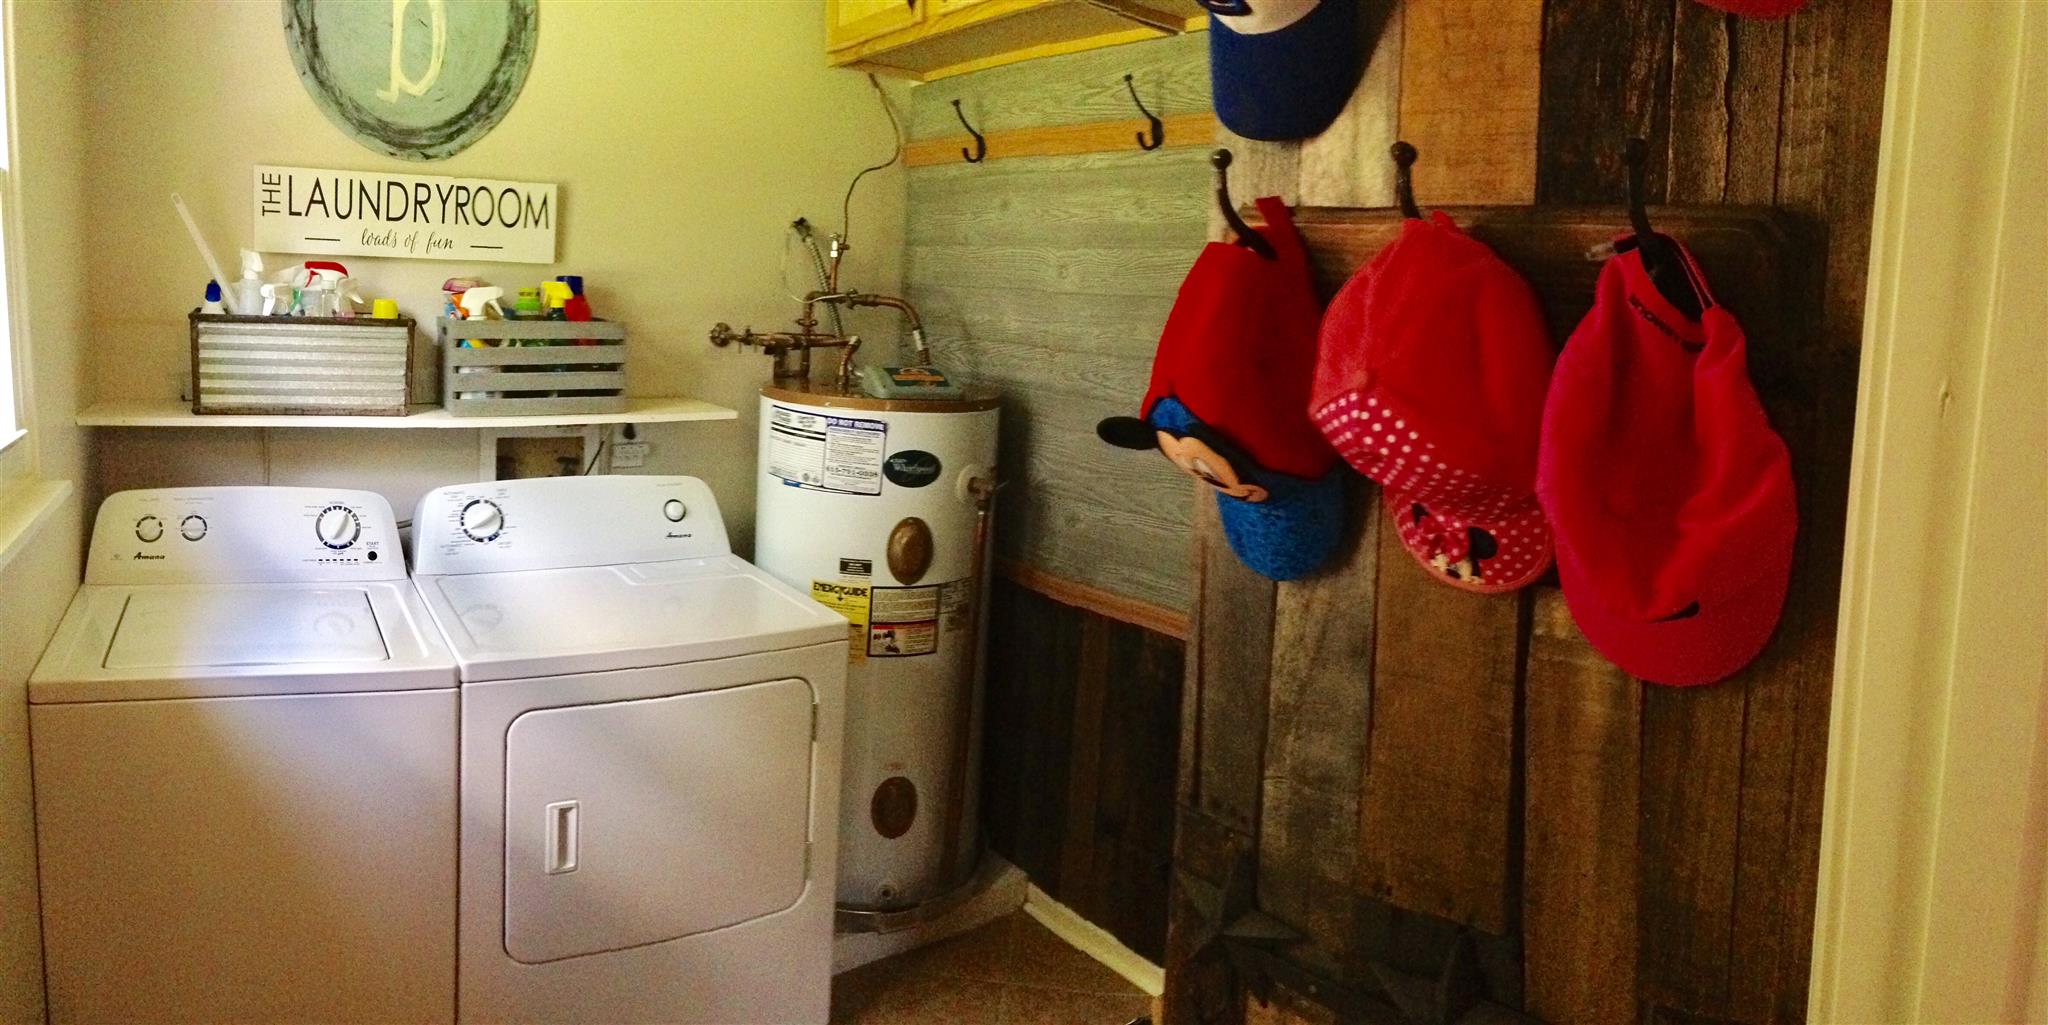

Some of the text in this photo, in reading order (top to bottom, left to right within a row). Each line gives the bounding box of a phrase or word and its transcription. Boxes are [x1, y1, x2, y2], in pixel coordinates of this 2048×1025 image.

[262, 173, 281, 216] THE
[361, 228, 454, 254] loads of fun
[826, 417, 838, 425] DO
[838, 418, 853, 428] NOT
[853, 420, 885, 431] REMOVE
